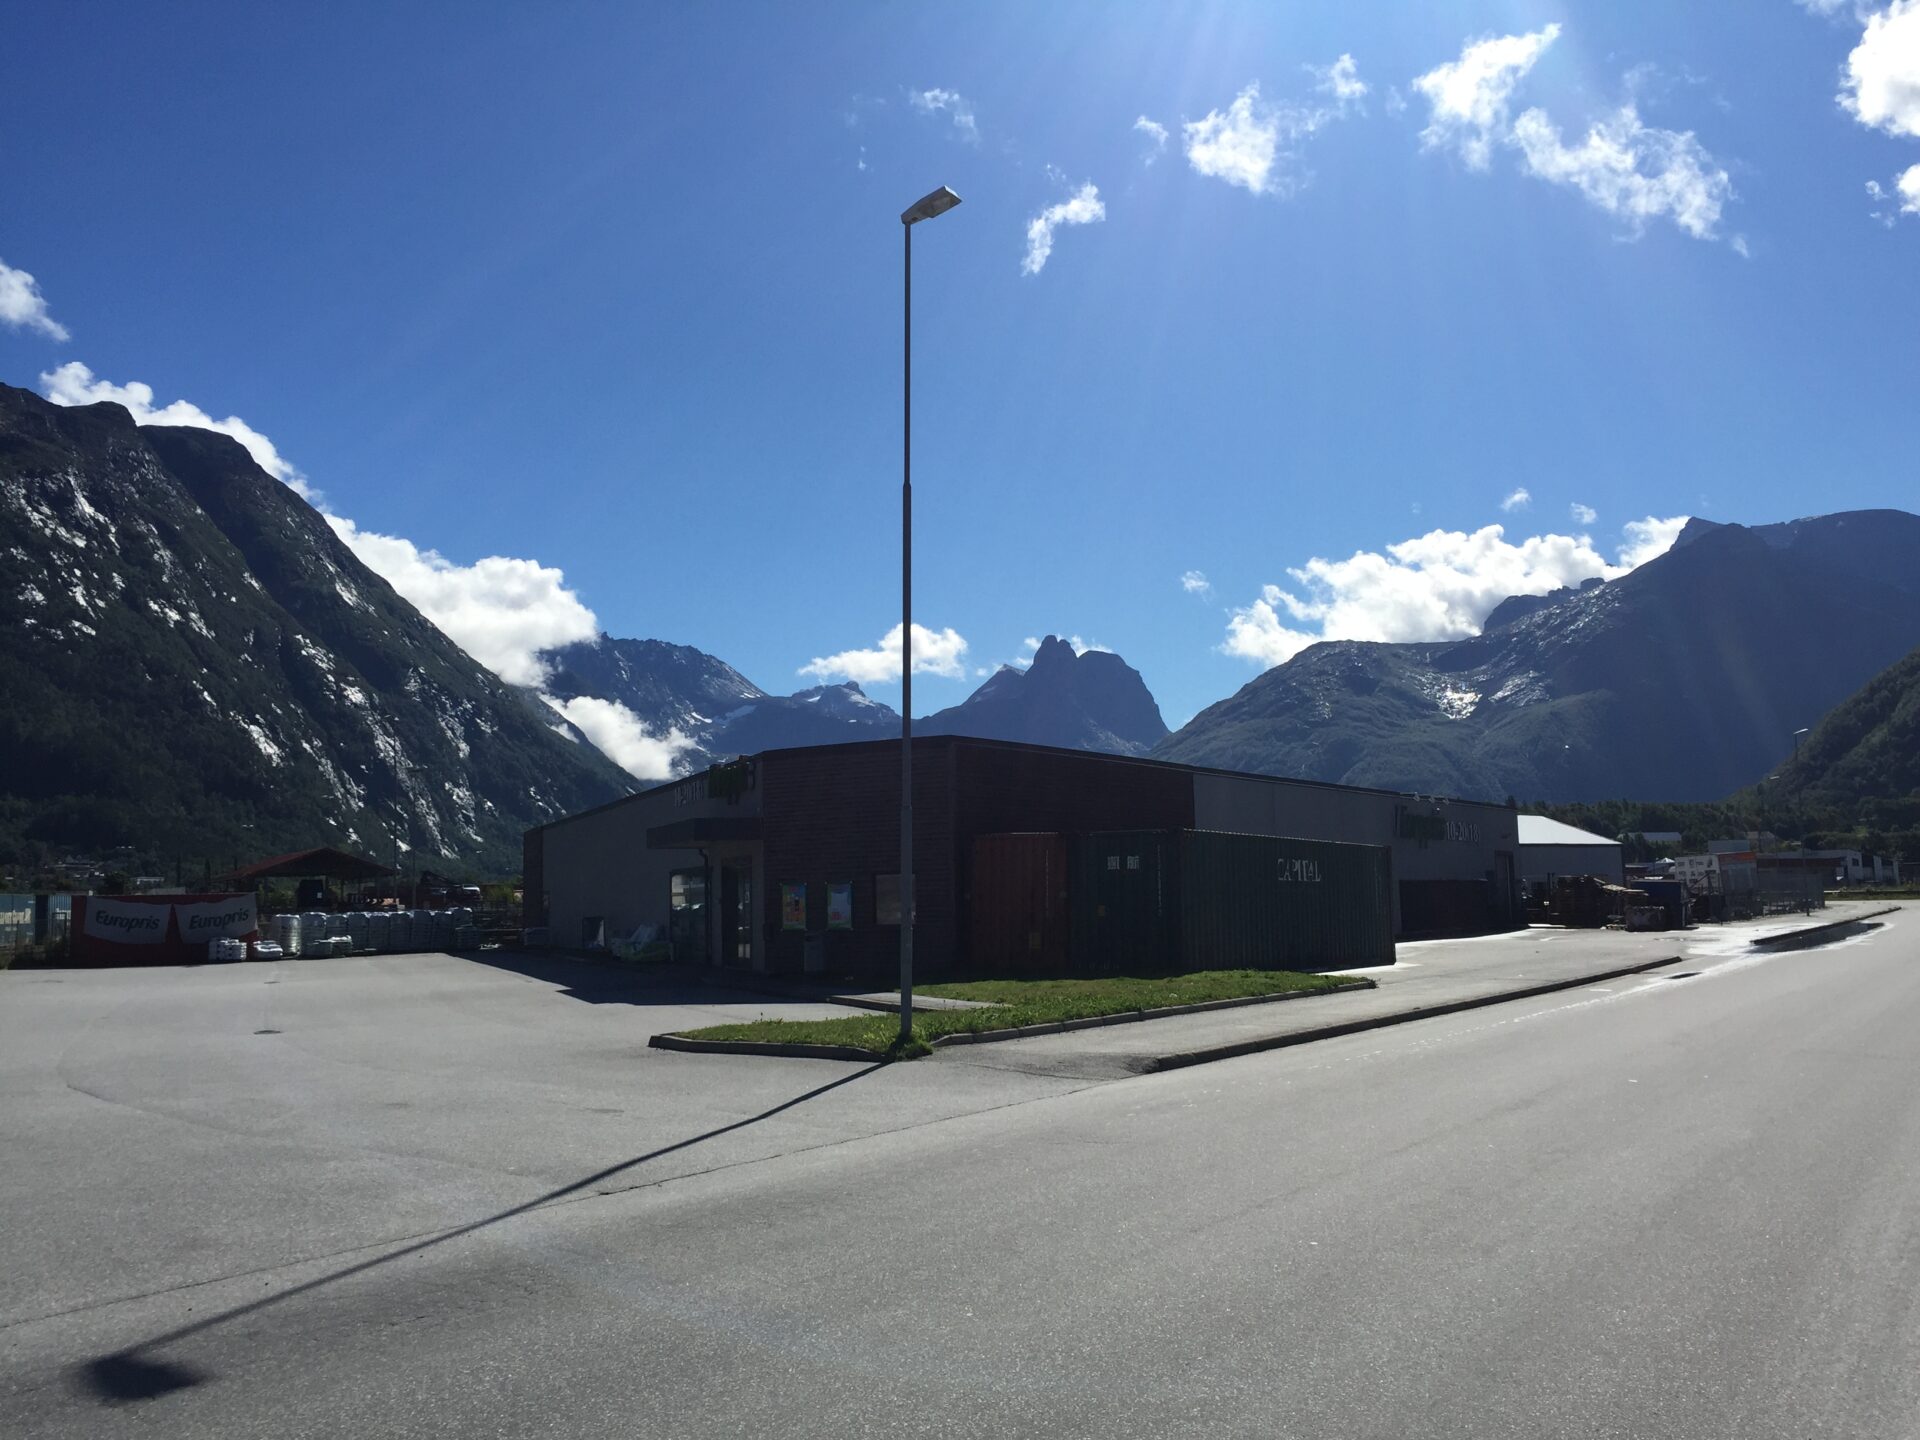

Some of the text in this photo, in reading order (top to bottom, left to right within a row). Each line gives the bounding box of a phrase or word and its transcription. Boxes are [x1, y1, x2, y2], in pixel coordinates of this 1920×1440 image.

[1277, 858, 1322, 882] CAPITAL
[95, 910, 160, 932] Europris
[189, 908, 249, 930] Europris
